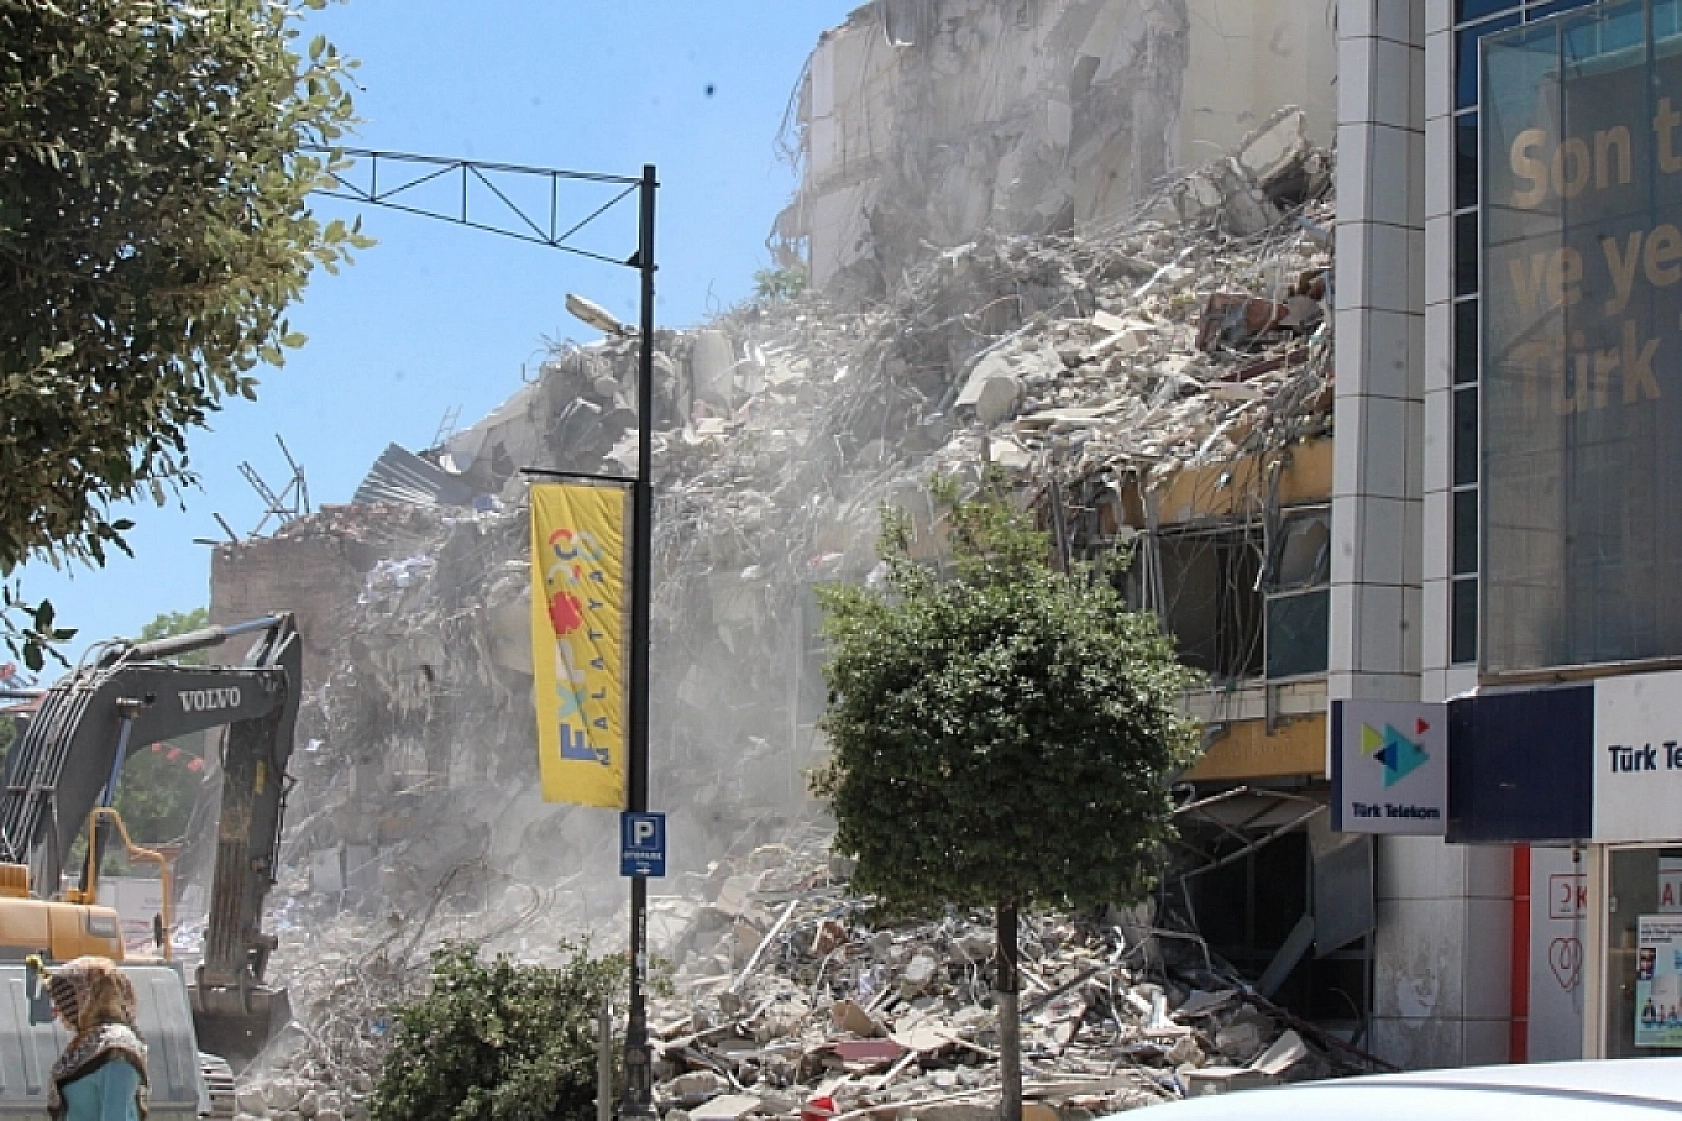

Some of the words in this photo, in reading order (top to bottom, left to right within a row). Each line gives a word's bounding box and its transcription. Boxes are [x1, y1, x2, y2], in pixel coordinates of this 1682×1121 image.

[1510, 126, 1631, 210] Son
[1508, 246, 1583, 317] ve
[1601, 224, 1682, 316] ye
[588, 569, 612, 766] MALATYA
[178, 686, 241, 712] VOLVO
[1608, 743, 1656, 773] Türk
[1352, 802, 1382, 818] Türk
[1384, 803, 1441, 819] Telekom
[633, 821, 655, 845] P
